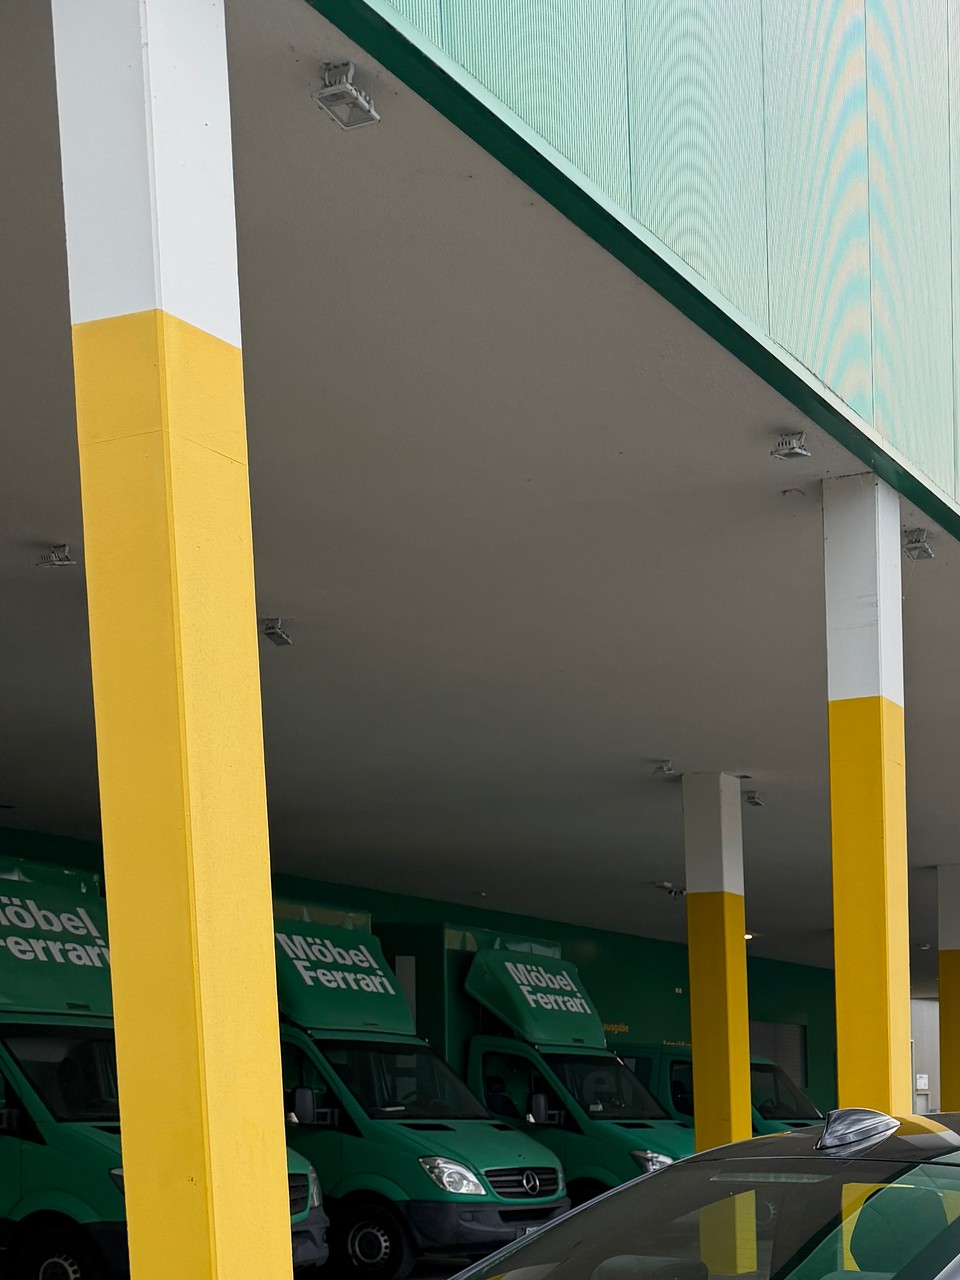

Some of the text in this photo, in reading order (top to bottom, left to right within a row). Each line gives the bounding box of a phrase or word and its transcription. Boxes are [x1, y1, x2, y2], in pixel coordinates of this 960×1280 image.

[0, 936, 110, 967] errari
[275, 932, 379, 969] Möbel
[292, 959, 396, 995] Ferrari
[504, 961, 578, 992] Möbel
[519, 985, 592, 1015] Ferrari
